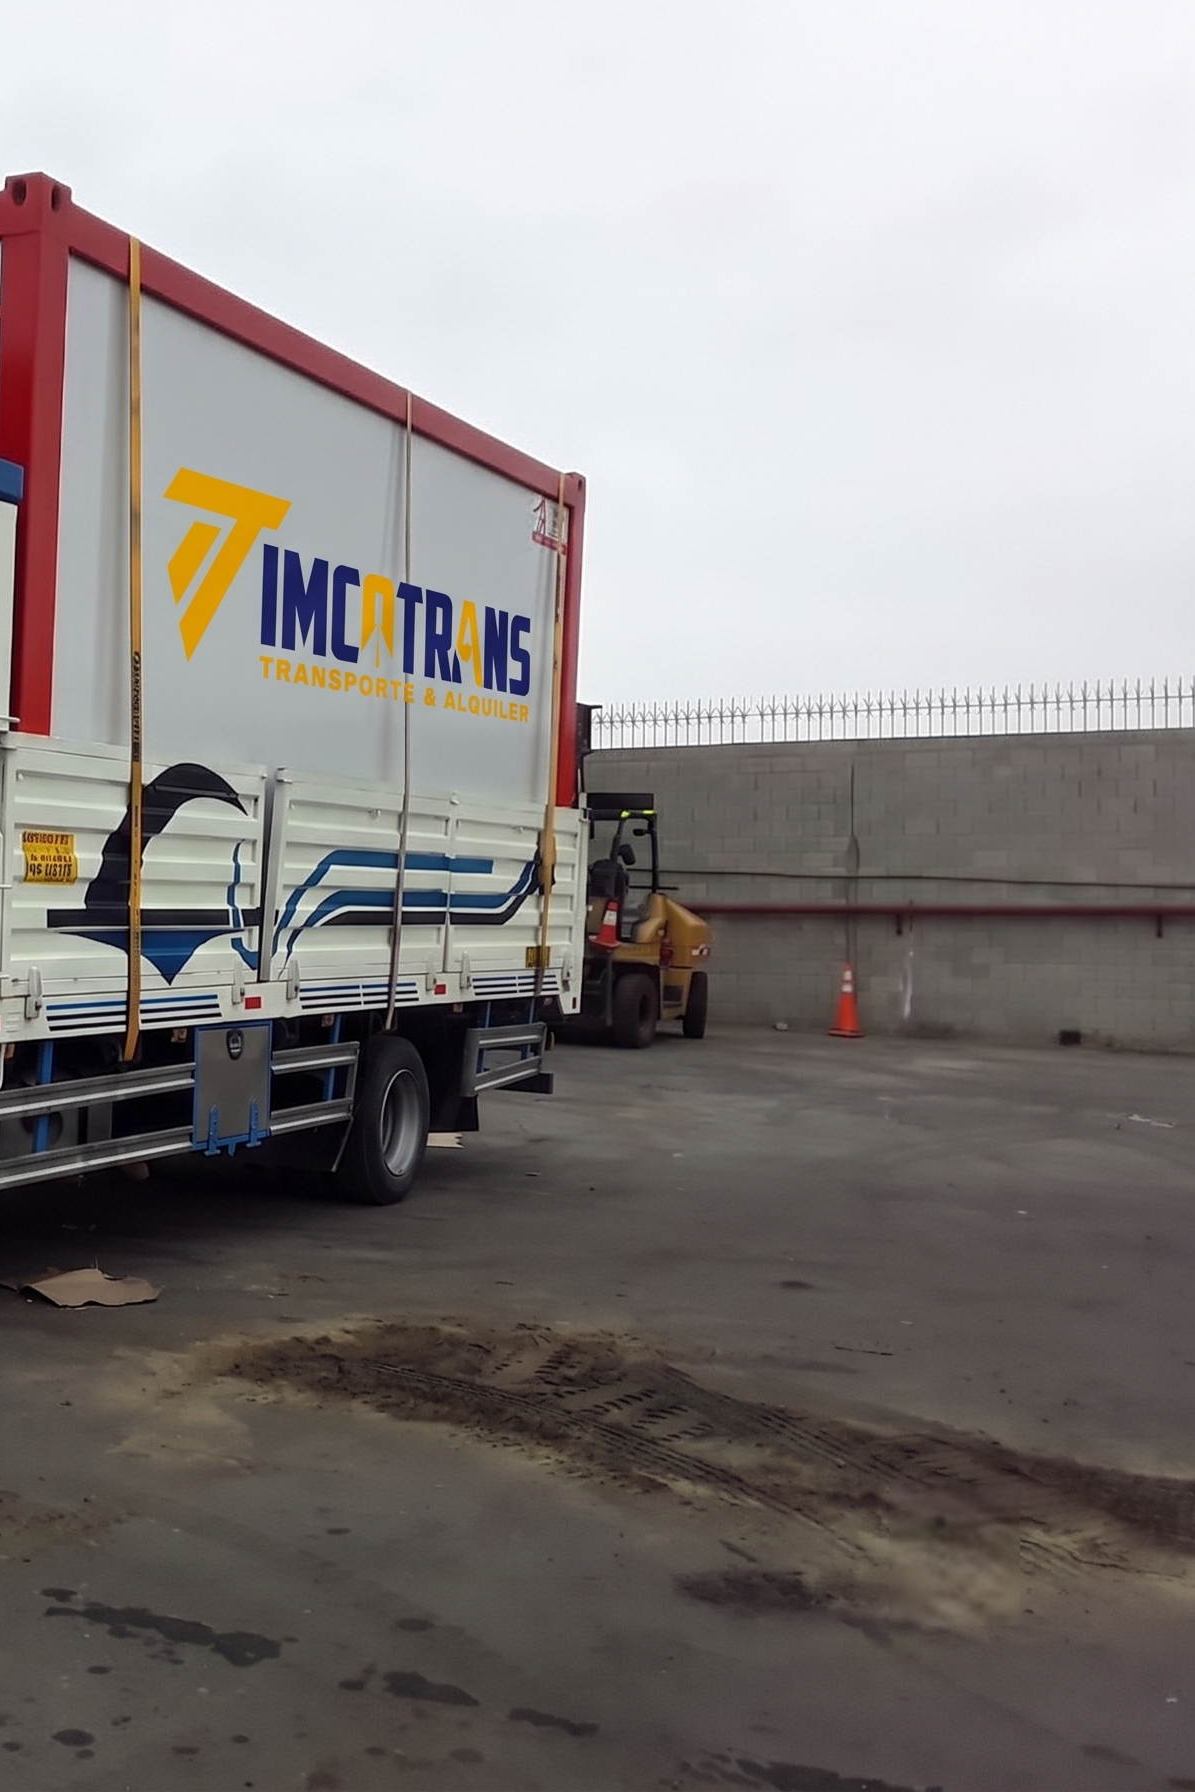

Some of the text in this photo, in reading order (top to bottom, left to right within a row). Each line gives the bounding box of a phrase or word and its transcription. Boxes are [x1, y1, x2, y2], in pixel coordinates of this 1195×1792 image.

[258, 654, 531, 723] TRANSPORTE & ALQUILER
